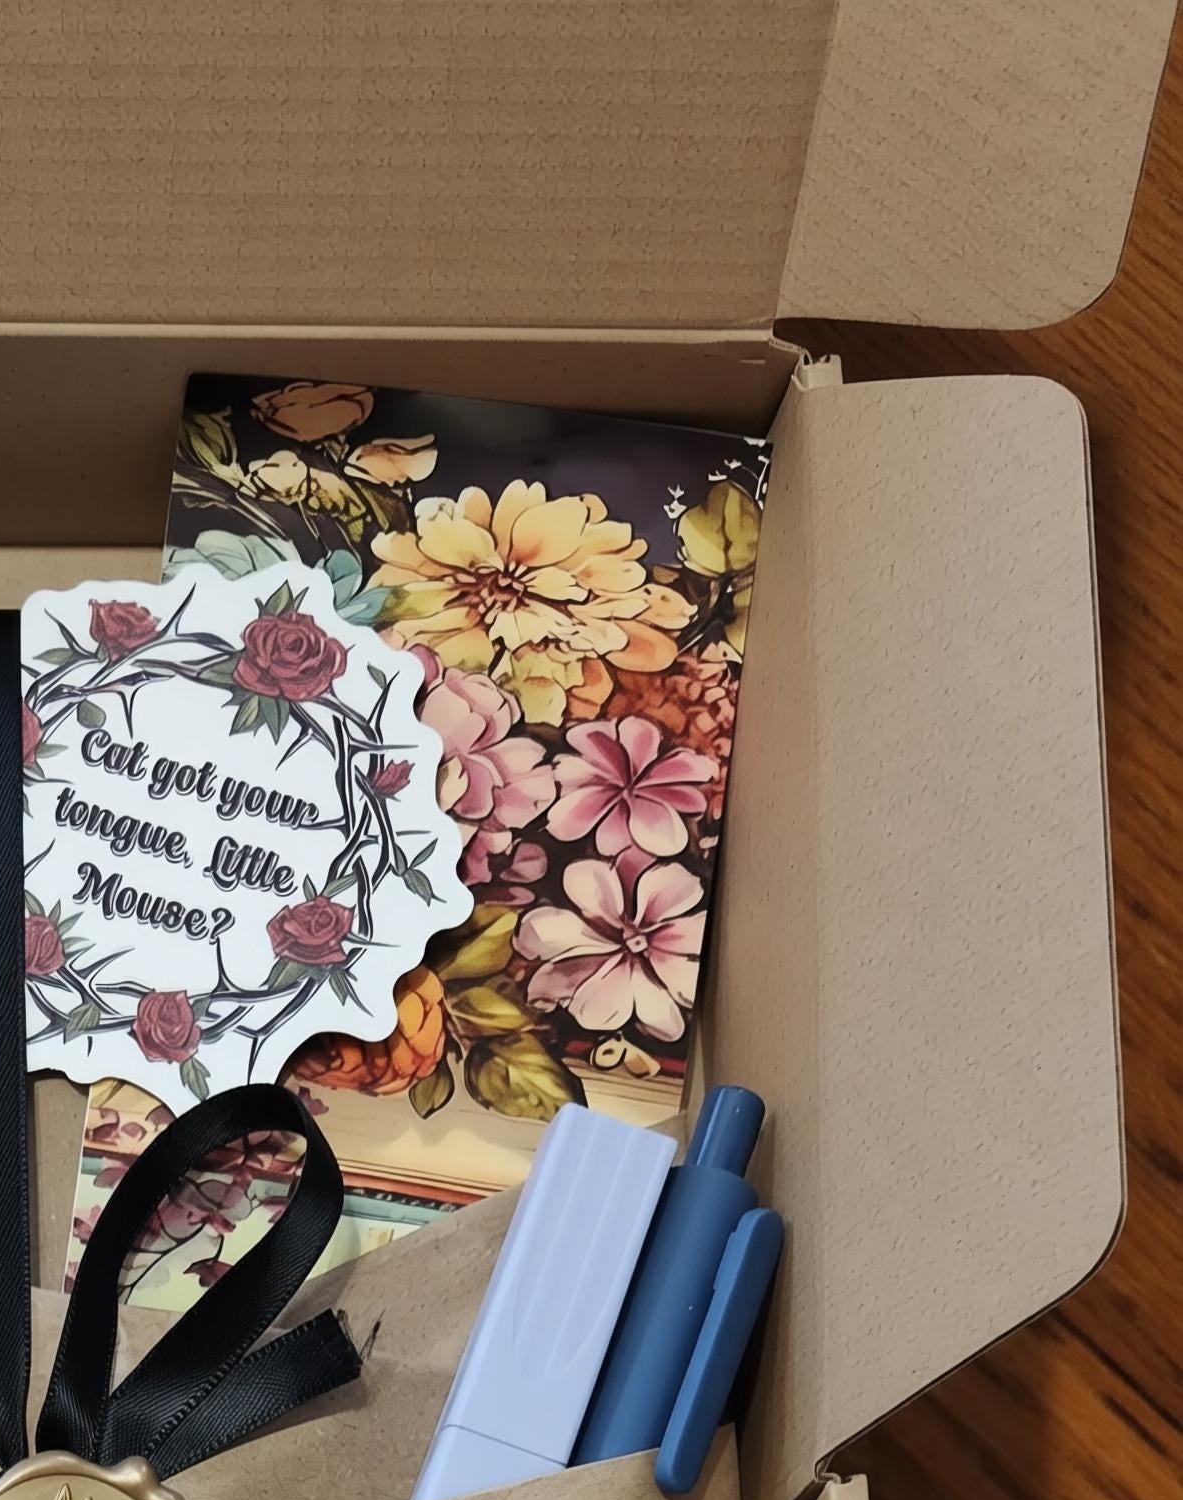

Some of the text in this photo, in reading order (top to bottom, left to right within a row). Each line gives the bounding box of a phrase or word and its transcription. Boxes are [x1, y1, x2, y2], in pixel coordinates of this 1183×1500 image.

[81, 728, 319, 828] Cat got your
[54, 786, 299, 895] tongue, Little
[72, 861, 235, 943] Mouse?
